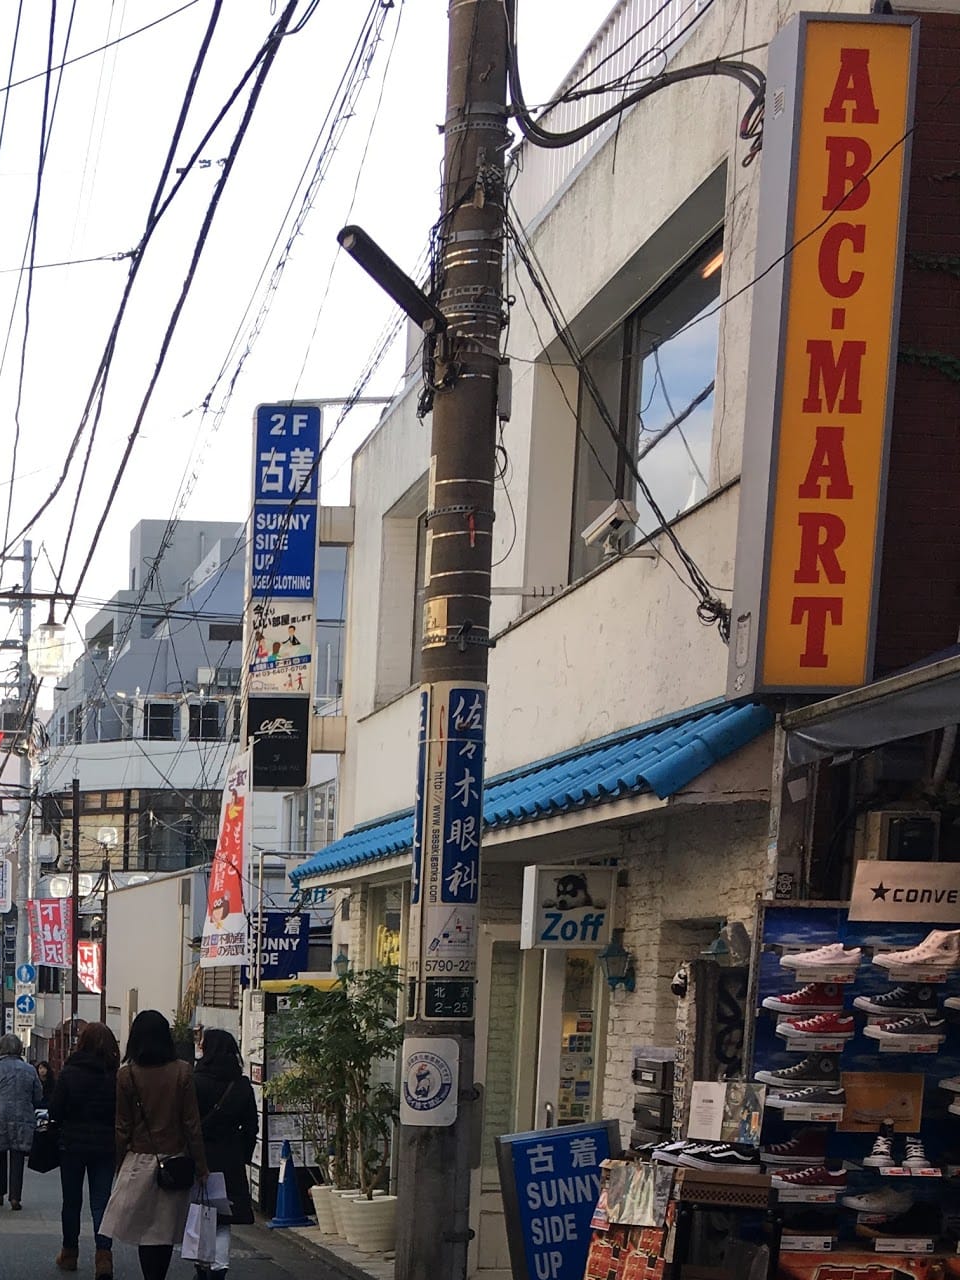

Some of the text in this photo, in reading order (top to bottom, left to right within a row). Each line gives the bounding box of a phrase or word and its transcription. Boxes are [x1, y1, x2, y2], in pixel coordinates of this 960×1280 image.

[790, 48, 879, 669] ABC-MART
[270, 414, 309, 436] 2F
[260, 447, 315, 494] 古着
[256, 513, 311, 531] SUNNY
[255, 533, 289, 551] SIDE
[254, 553, 274, 570] UP
[273, 575, 311, 590] CLOTHING
[445, 693, 484, 899] 佐々木眼科
[541, 913, 605, 941] Zoff
[434, 1002, 469, 1013] 2-25
[527, 1137, 597, 1175] 古着
[526, 1174, 601, 1210] SUNNY
[531, 1213, 578, 1246] SIDE
[534, 1251, 563, 1280] UP
